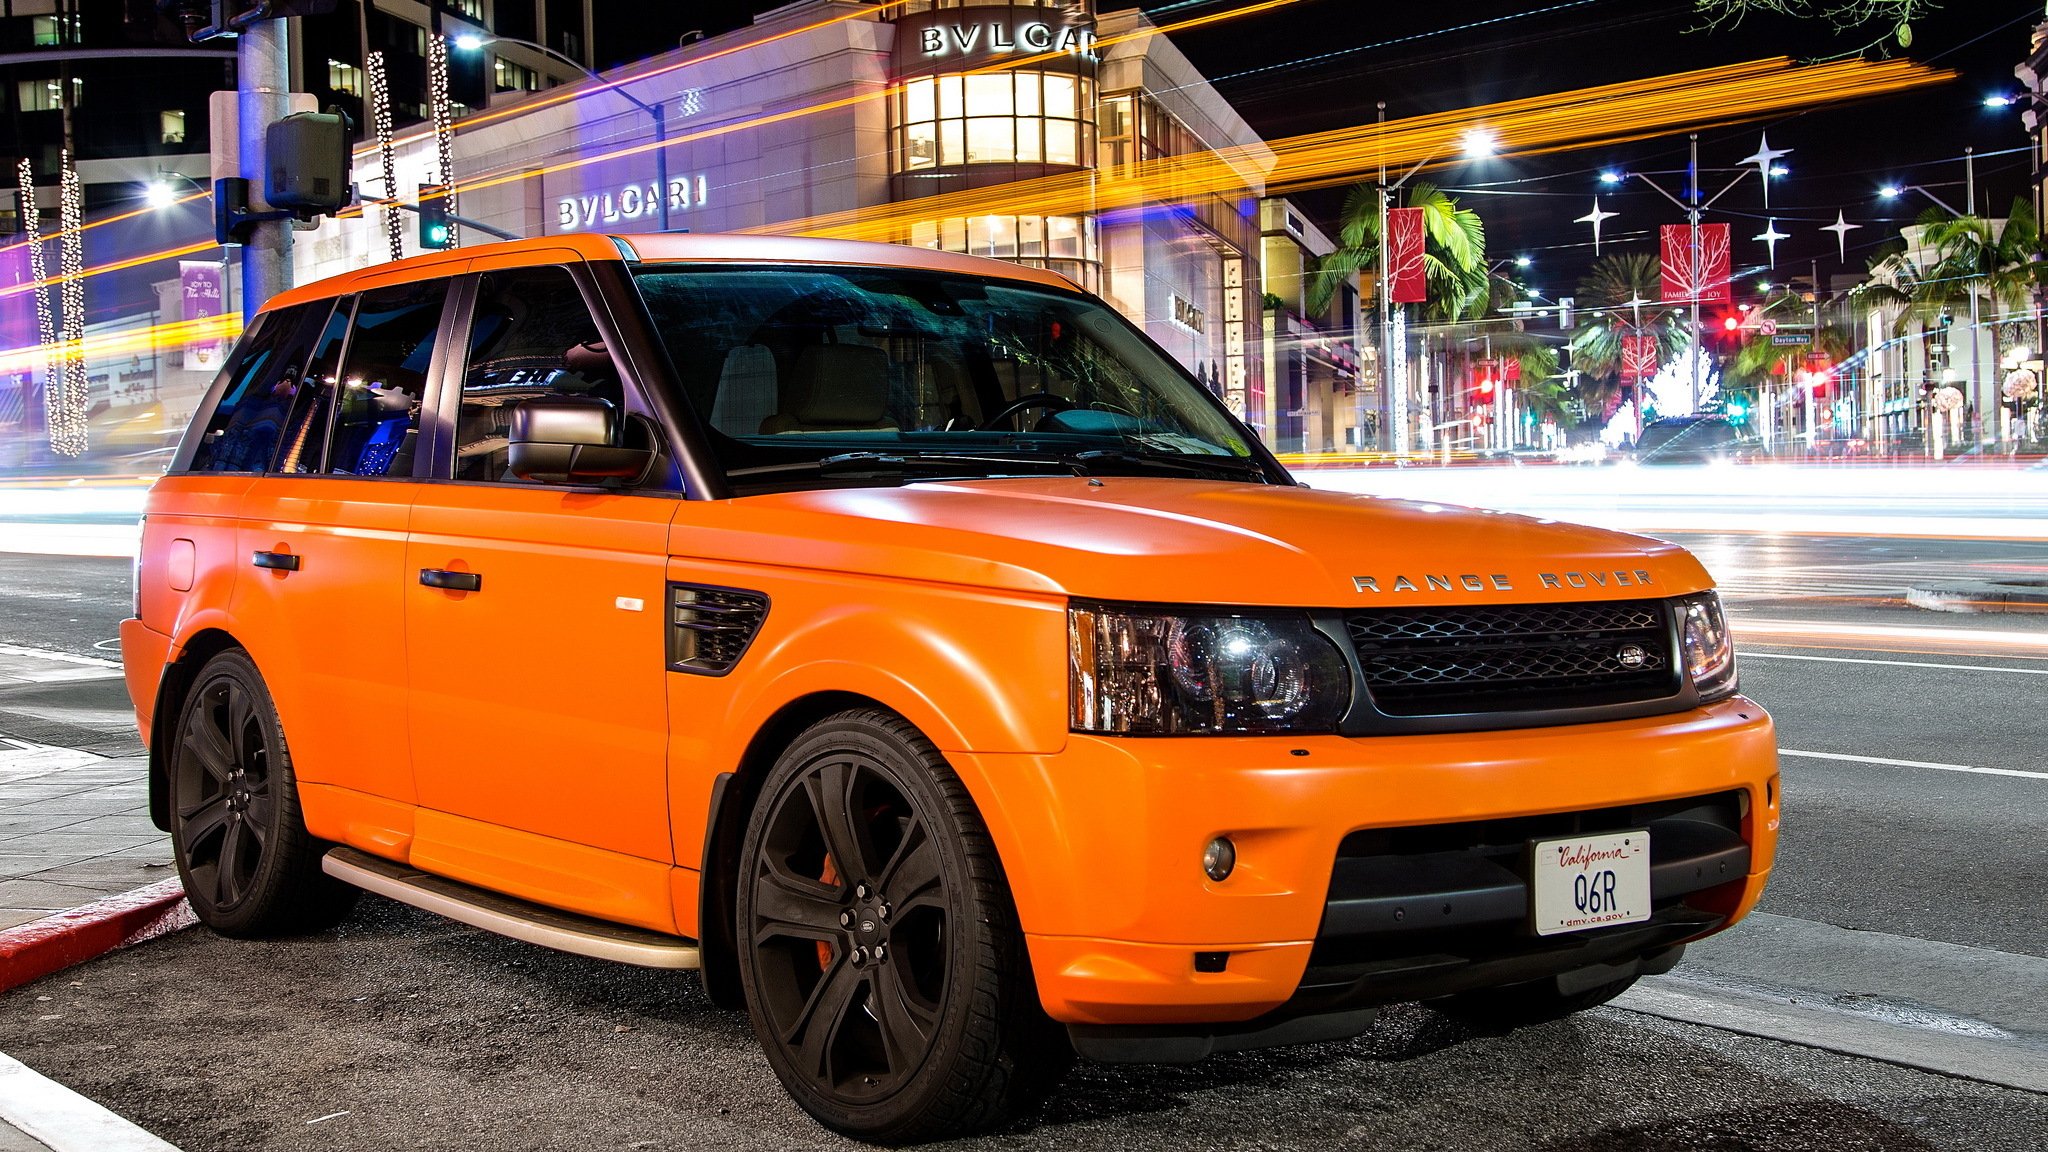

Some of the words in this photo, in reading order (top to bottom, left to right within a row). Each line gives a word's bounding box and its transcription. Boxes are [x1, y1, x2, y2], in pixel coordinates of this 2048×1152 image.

[559, 175, 706, 229] BVLGARI
[1775, 336, 1796, 344] Dayton
[1351, 573, 1513, 593] RANGE
[1538, 569, 1654, 589] ROVER
[1560, 843, 1629, 870] California
[1574, 870, 1617, 915] Q6R
[1566, 913, 1624, 927] dmv.ca.gov
